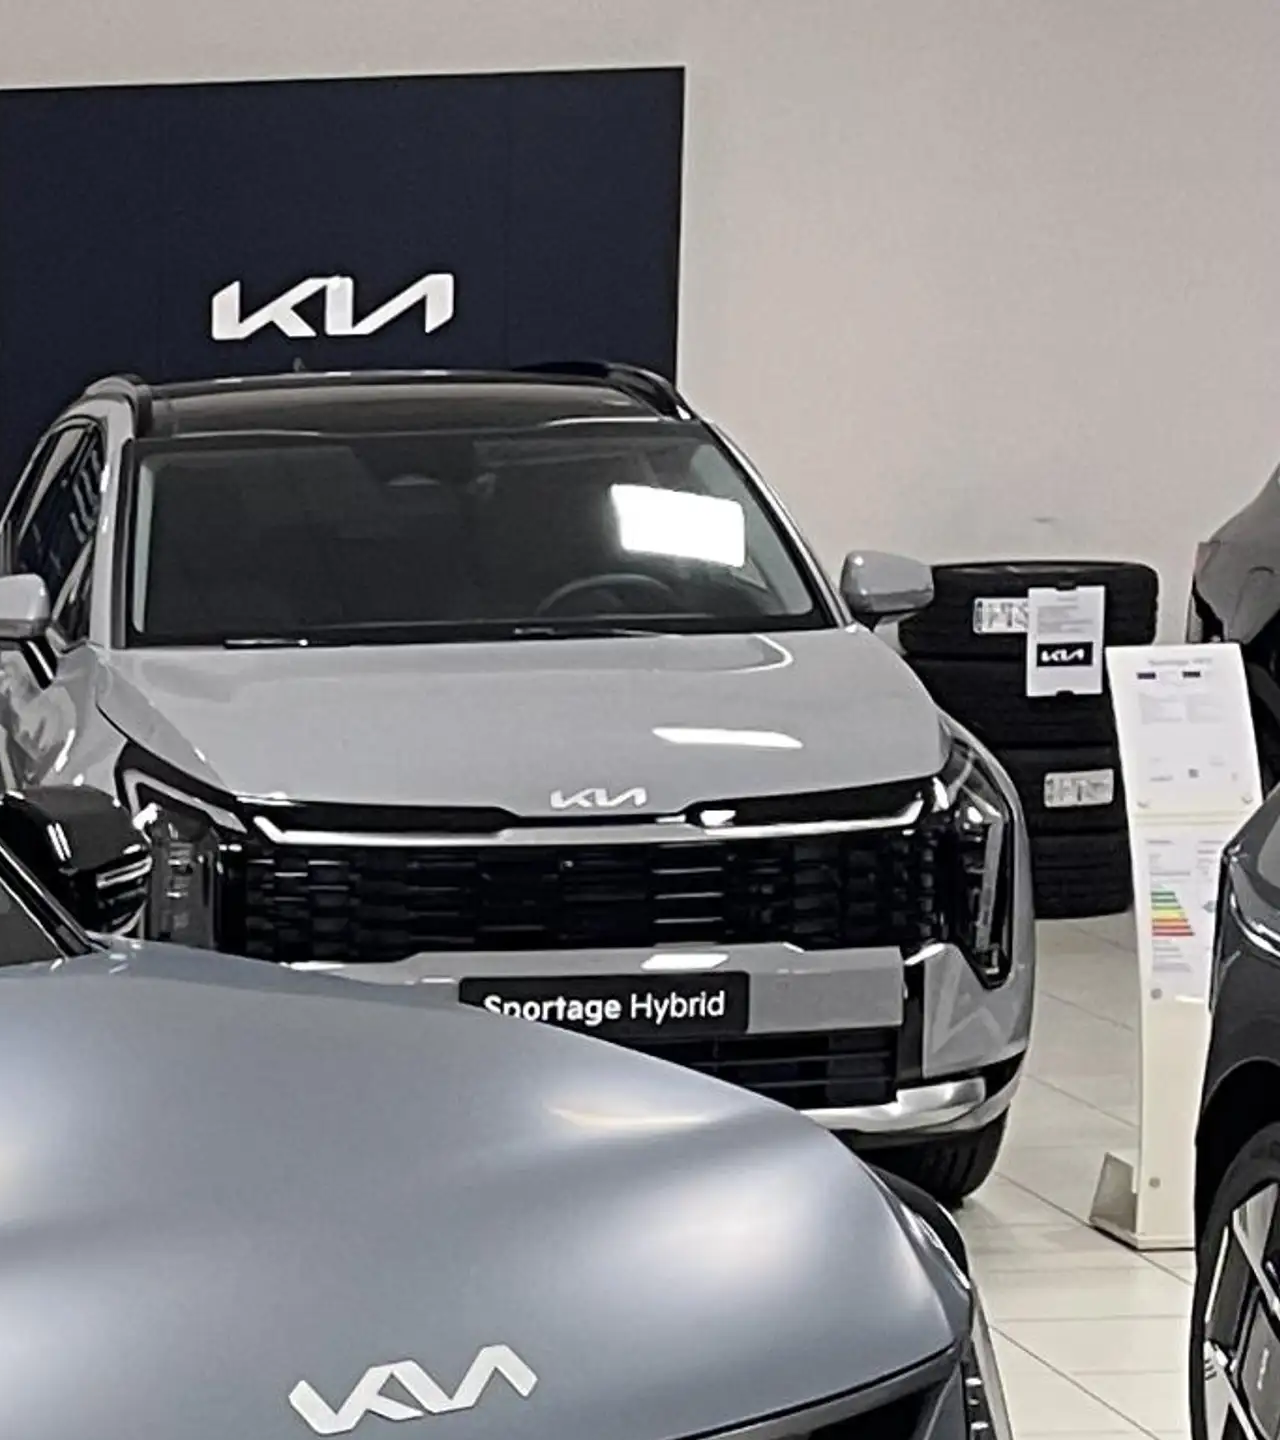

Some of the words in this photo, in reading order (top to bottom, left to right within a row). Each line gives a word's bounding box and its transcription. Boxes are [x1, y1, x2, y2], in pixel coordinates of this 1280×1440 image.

[211, 272, 454, 340] KIA
[1041, 649, 1084, 662] KIA
[550, 787, 647, 809] KIA
[630, 990, 726, 1024] Hybrid
[289, 1343, 538, 1436] KIA
